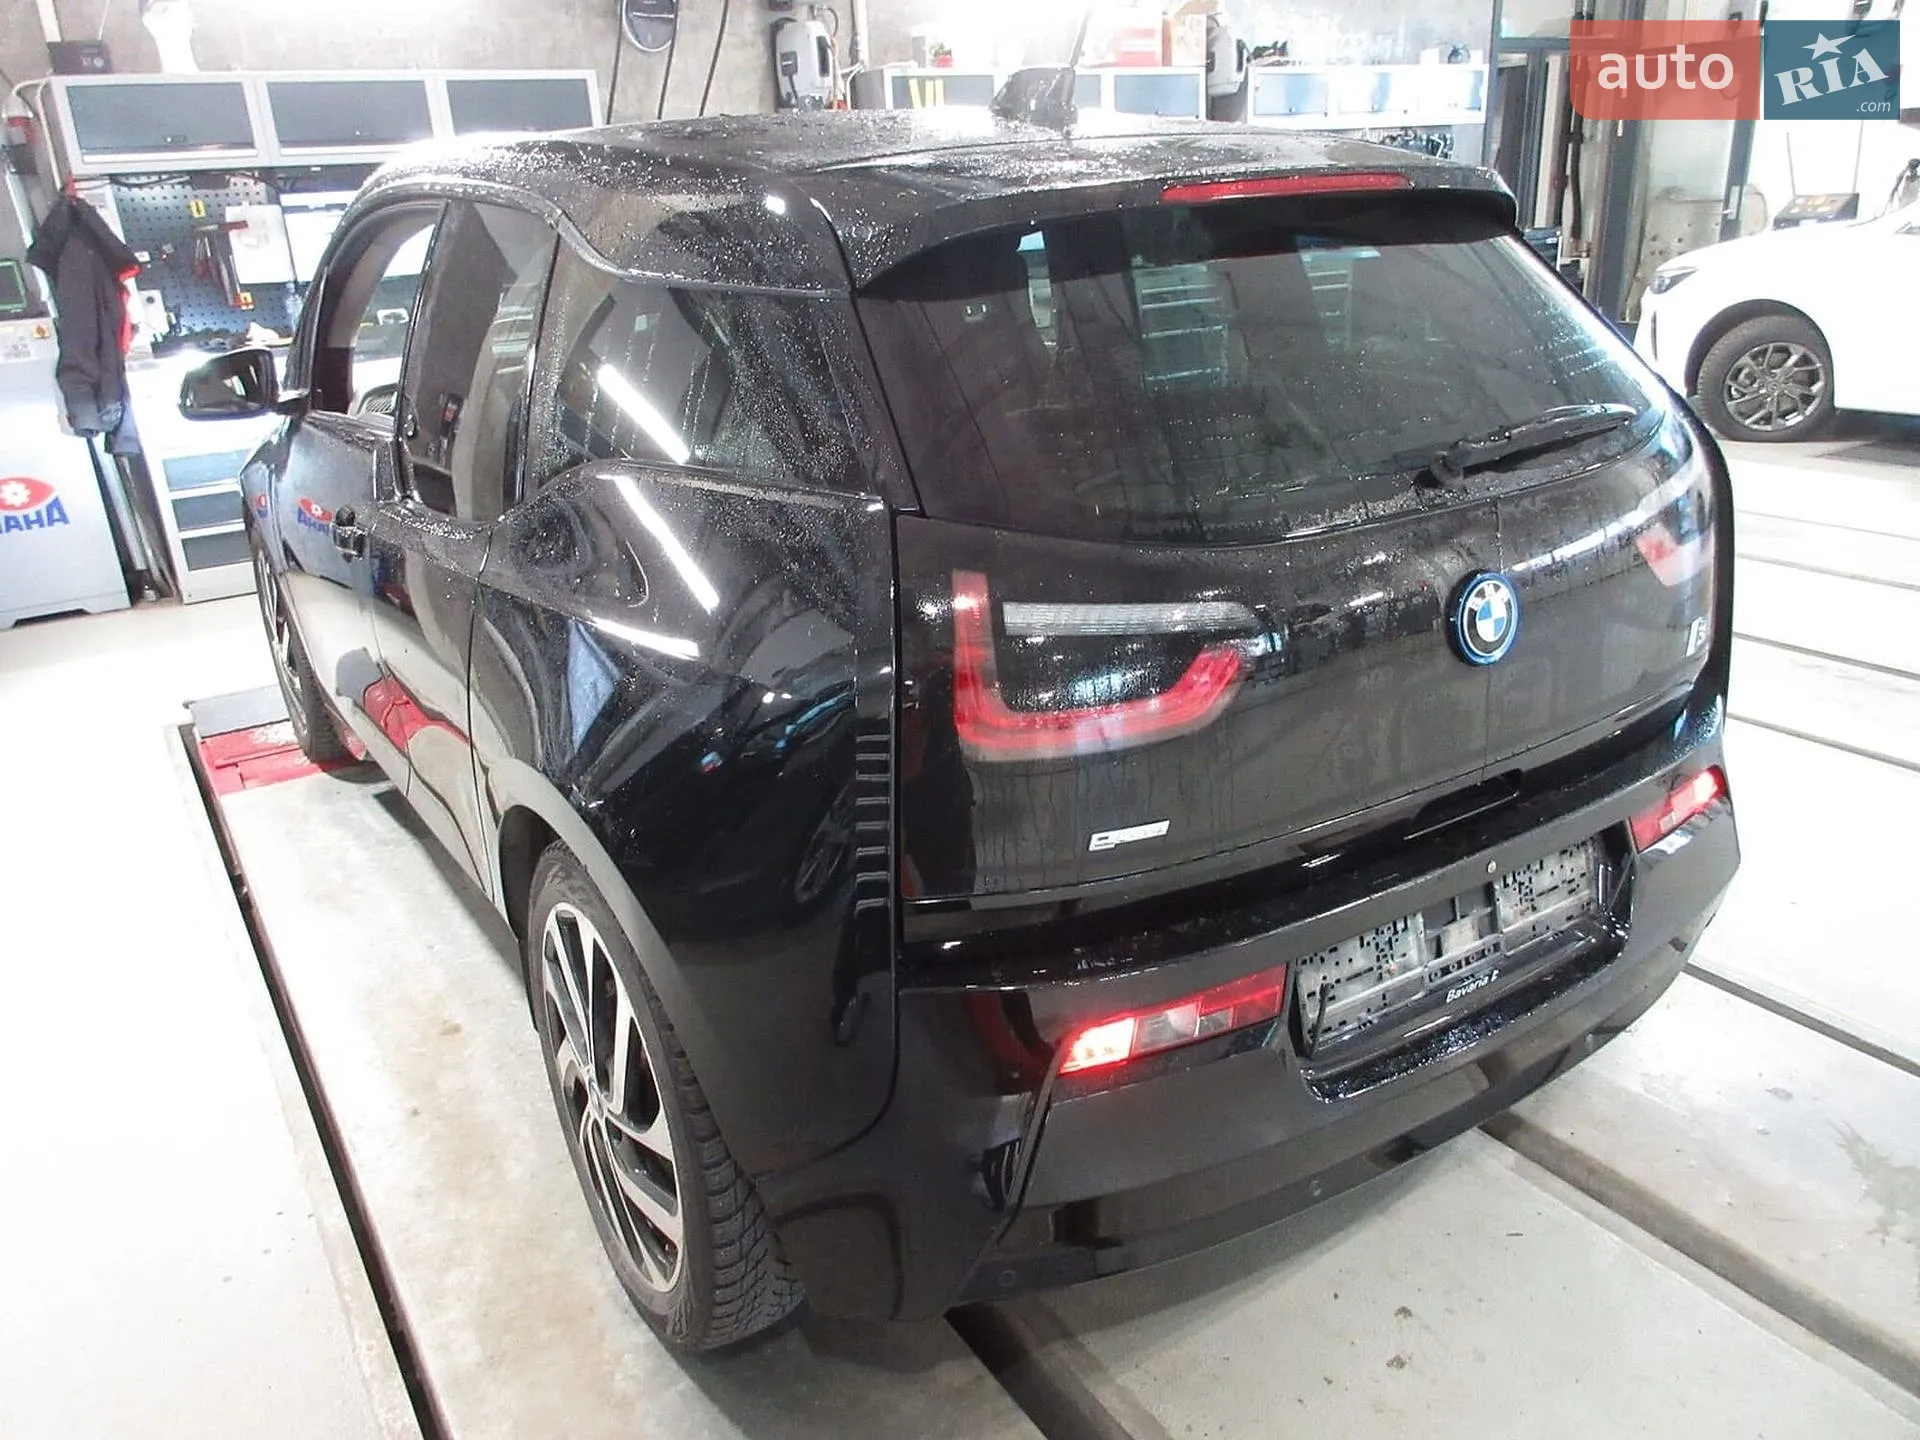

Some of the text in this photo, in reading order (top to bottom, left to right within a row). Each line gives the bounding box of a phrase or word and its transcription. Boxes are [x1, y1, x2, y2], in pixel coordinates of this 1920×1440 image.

[0, 497, 70, 534] AHA
[1466, 582, 1511, 611] BMW
[1446, 976, 1489, 1003] Bavaria
